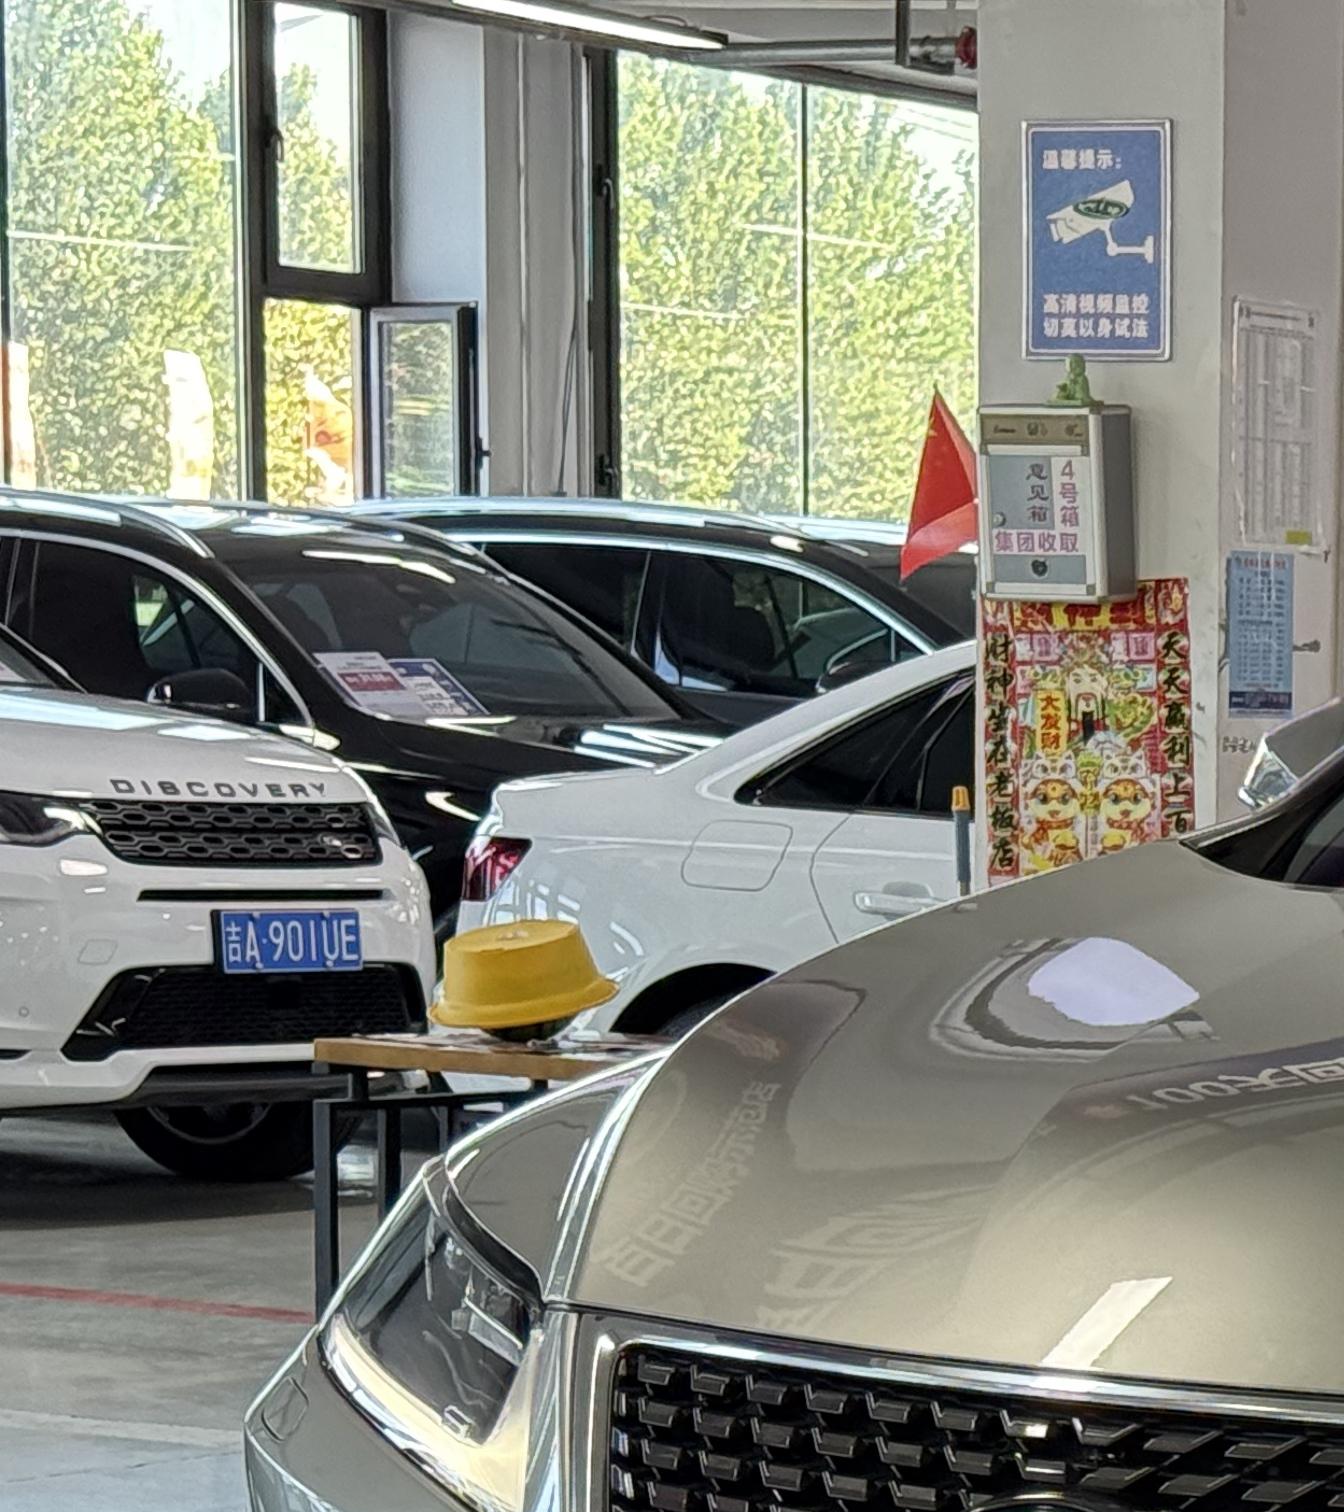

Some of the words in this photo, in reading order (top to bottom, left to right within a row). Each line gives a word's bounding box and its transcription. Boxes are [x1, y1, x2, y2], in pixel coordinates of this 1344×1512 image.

[1043, 293, 1150, 315] 高清视频监控
[1043, 317, 1149, 339] 切莫以身试法
[1026, 463, 1050, 523] 意见箱
[1059, 459, 1080, 528] 4号箱
[994, 531, 1080, 553] 集团收取
[109, 778, 325, 798] DISCOVERY
